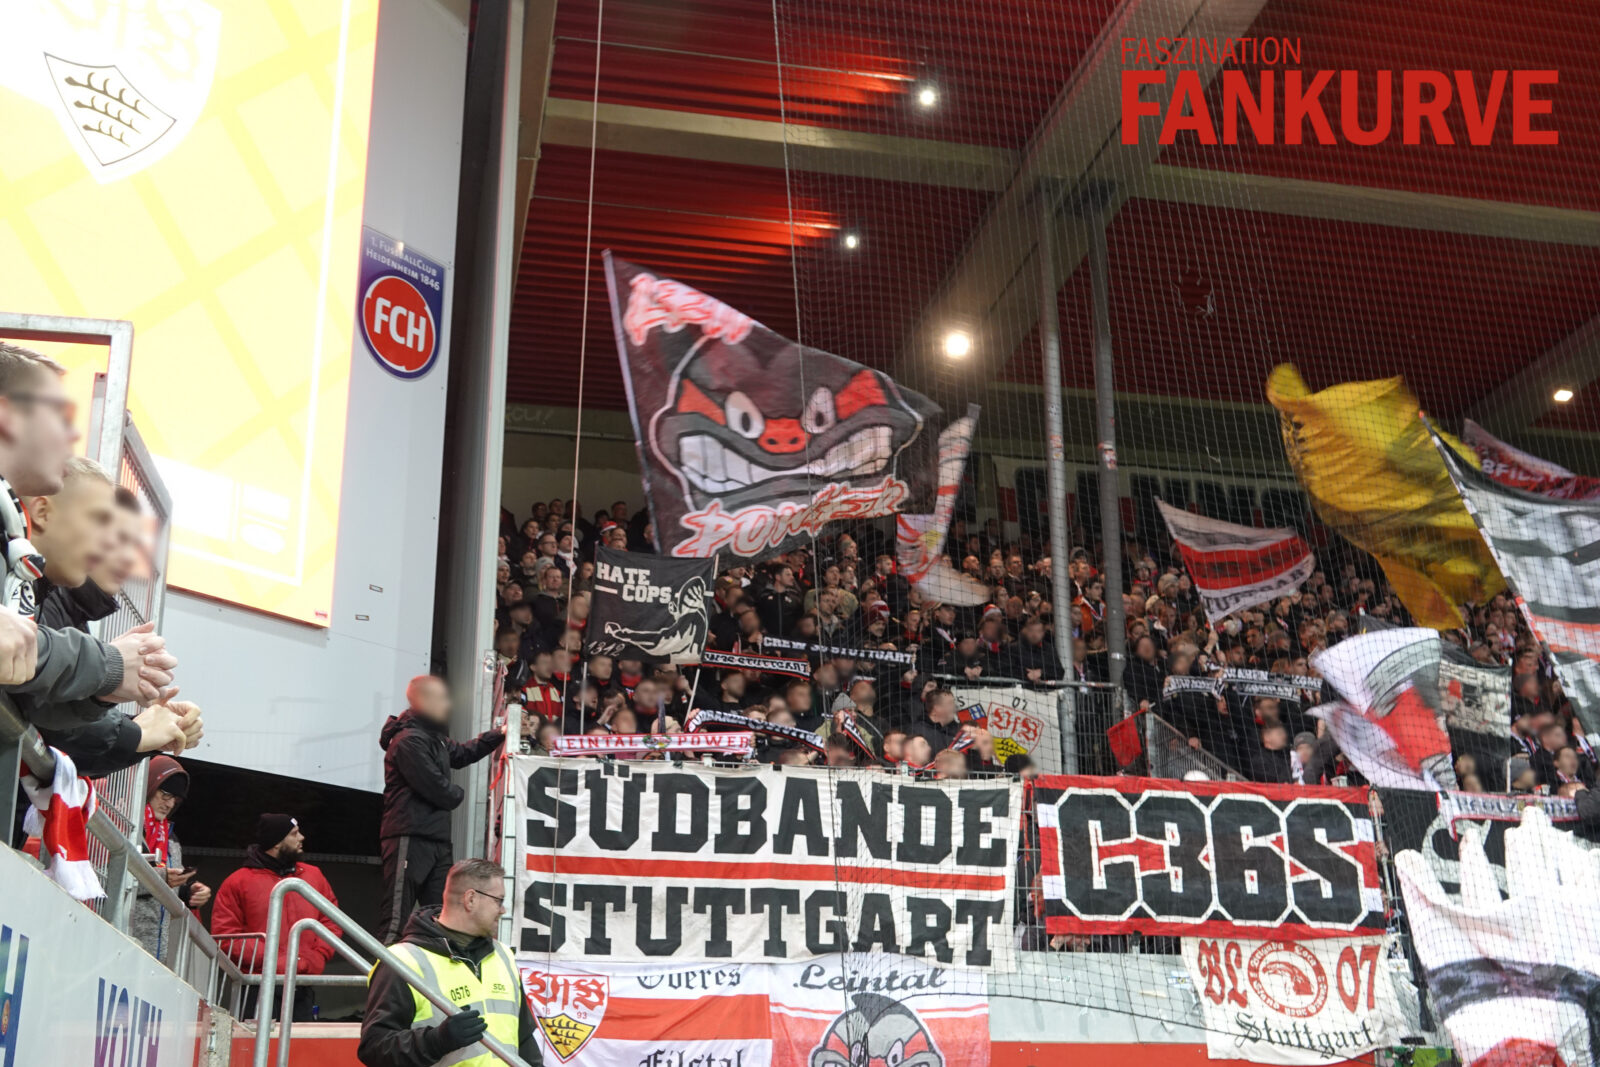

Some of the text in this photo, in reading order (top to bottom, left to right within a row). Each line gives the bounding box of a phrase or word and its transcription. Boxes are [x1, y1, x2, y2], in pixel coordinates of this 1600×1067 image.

[420, 273, 440, 291] 1846
[373, 296, 427, 352] FCH
[596, 561, 651, 586] HATE
[622, 584, 672, 604] COPS
[588, 640, 626, 657] 1312
[763, 636, 807, 650] CREW
[677, 733, 750, 748] POWER
[526, 763, 1010, 868] SÜDBANDE
[1055, 787, 1370, 932] C36S
[519, 880, 1006, 967] STUTTGART
[793, 963, 947, 992] Leintal
[1336, 944, 1382, 1014] 07
[450, 985, 471, 1002] 0576
[576, 1011, 588, 1021] 93
[1233, 1011, 1377, 1060] Stuttgart
